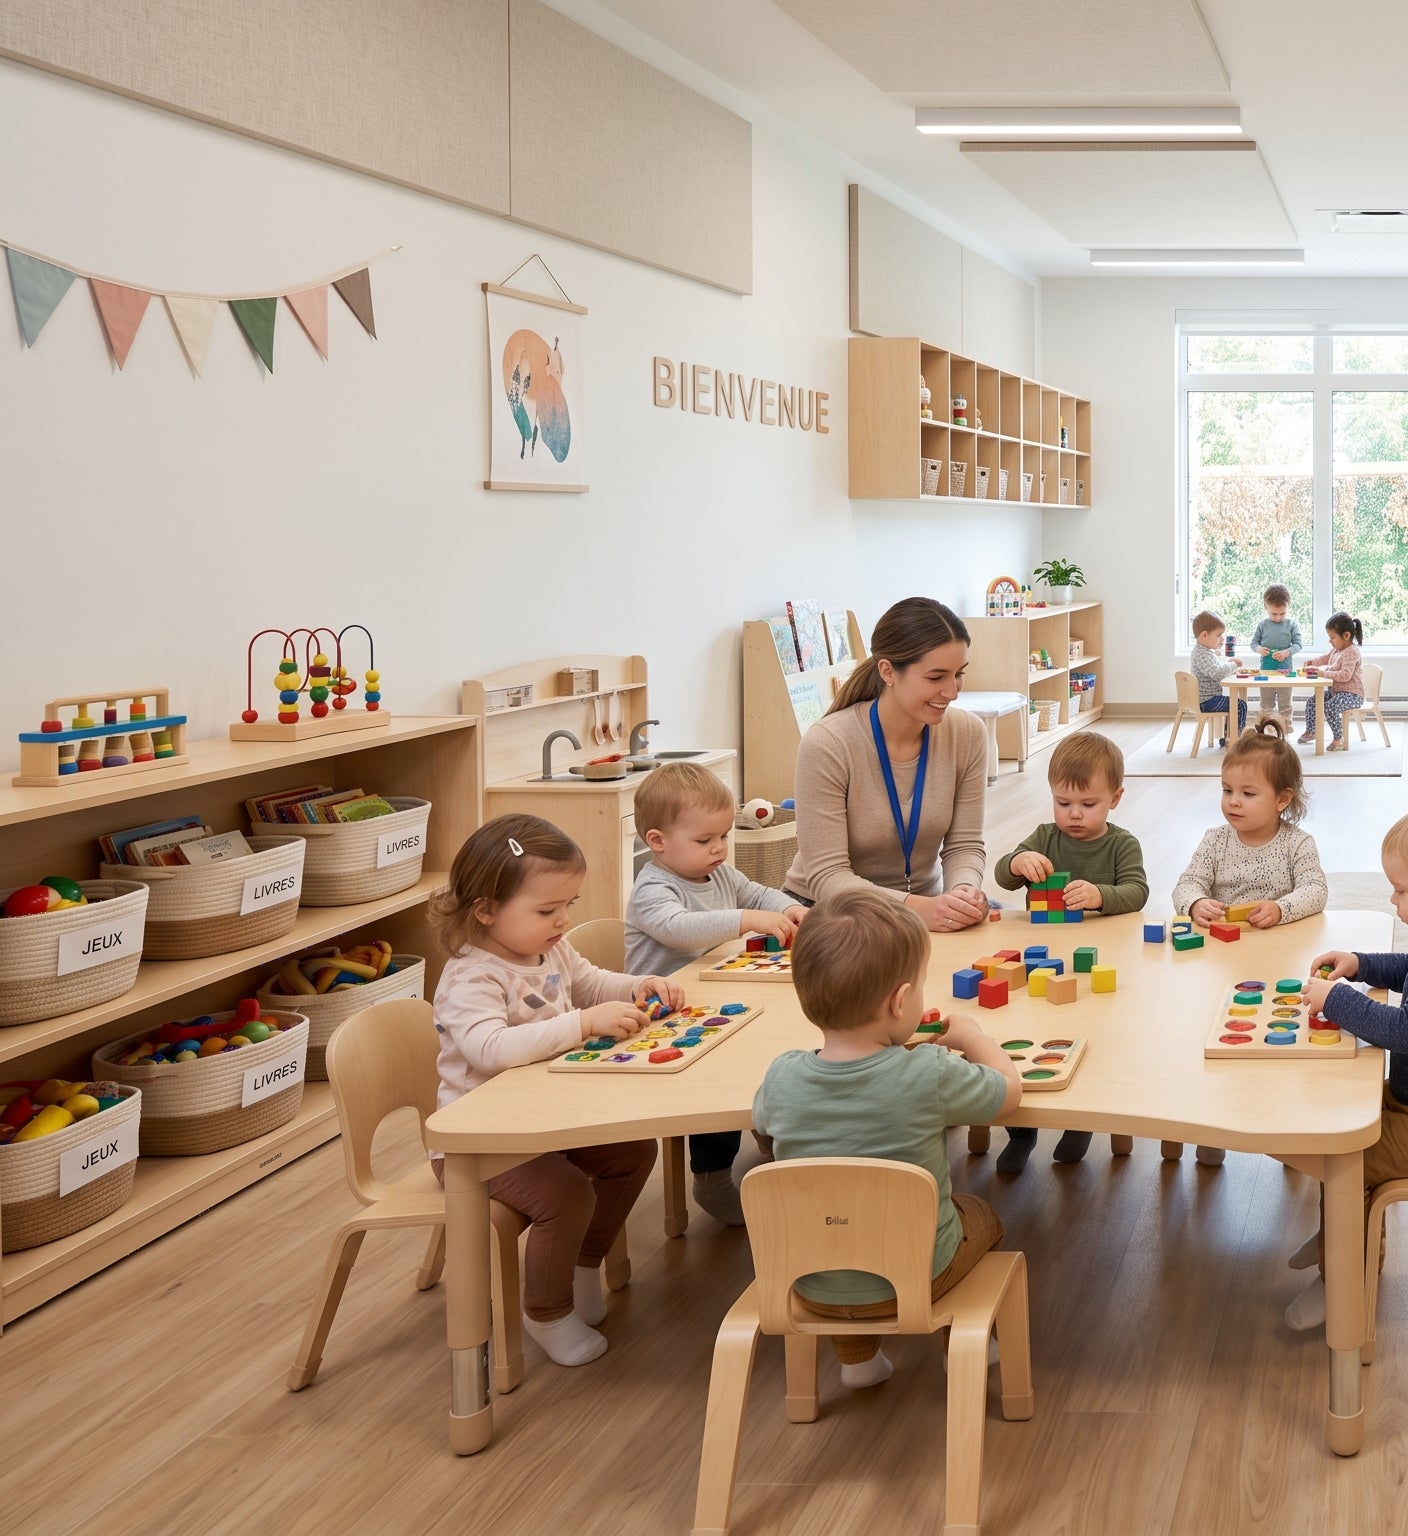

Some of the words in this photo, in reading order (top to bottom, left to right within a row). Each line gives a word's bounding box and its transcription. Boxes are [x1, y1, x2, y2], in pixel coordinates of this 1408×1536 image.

[652, 356, 830, 434] BIENVENUE
[386, 834, 420, 856] LIVRES
[253, 875, 296, 900] LIVRES
[81, 930, 123, 956] JEUX
[253, 1060, 298, 1092] LIVRES
[81, 1139, 119, 1171] JEUX
